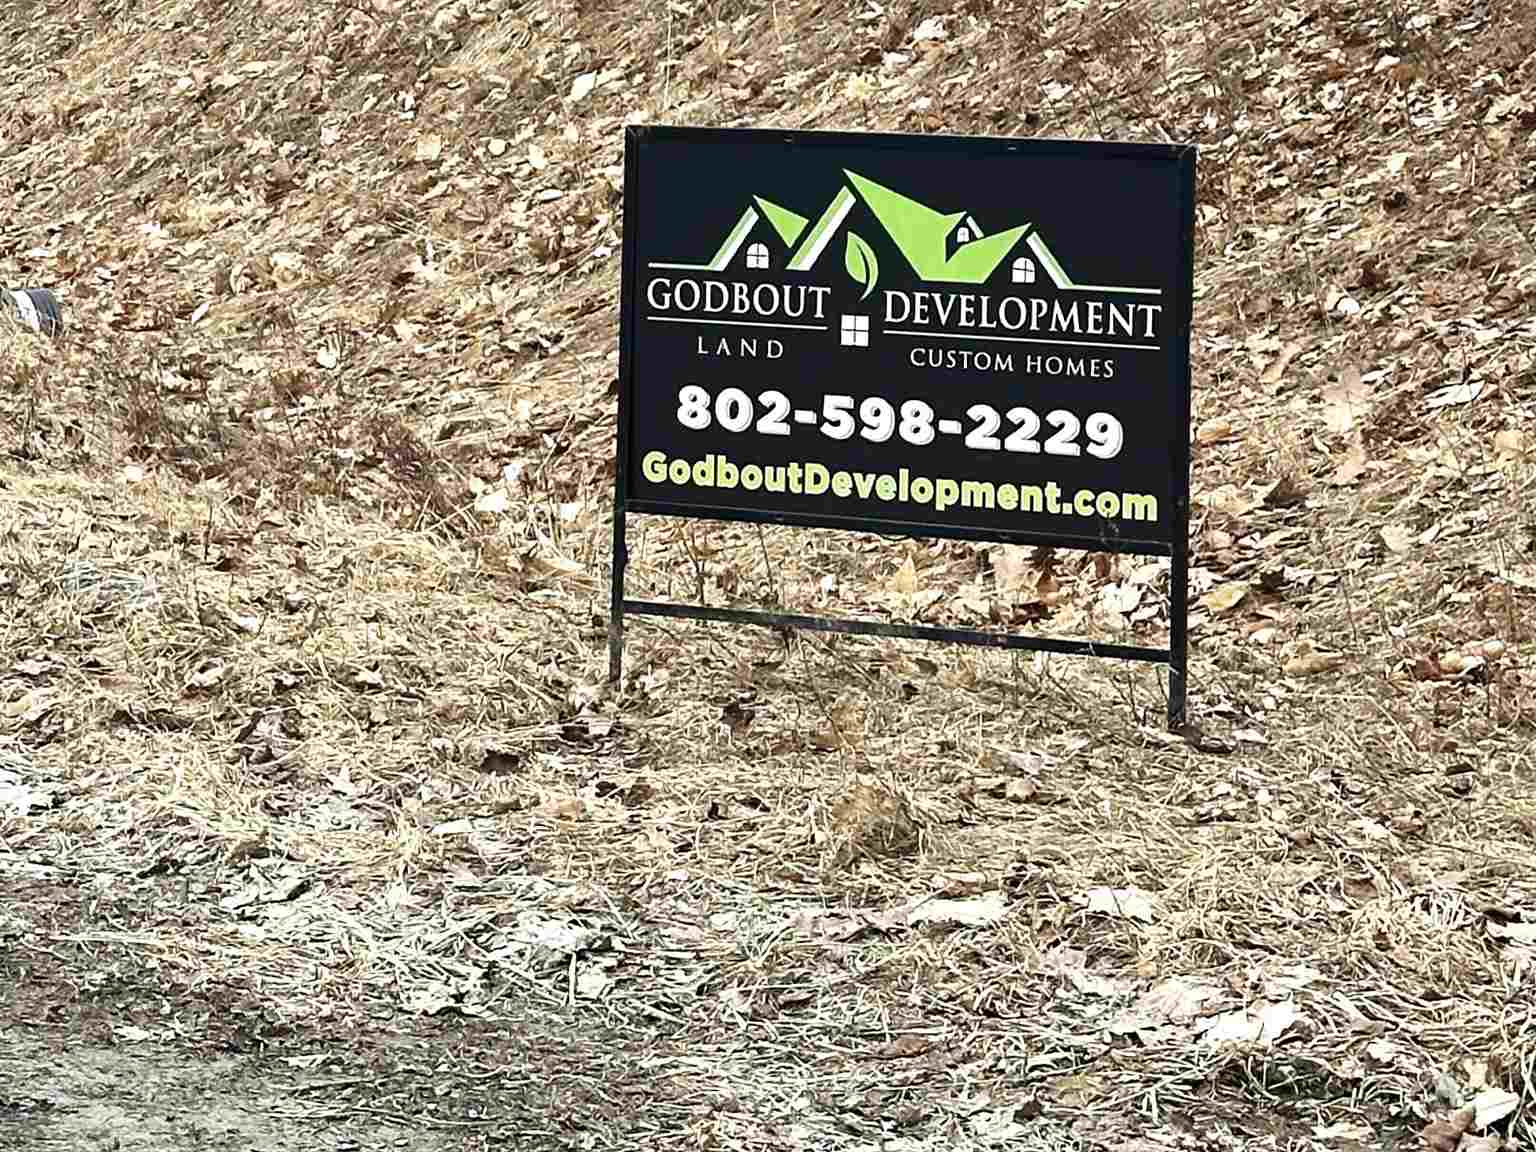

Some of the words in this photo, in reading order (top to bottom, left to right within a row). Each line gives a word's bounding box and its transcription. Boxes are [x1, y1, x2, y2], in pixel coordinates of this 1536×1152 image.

[646, 277, 831, 319] GODBOUT
[884, 289, 1163, 338] DEVELOPMENT
[697, 336, 785, 360] LAND
[910, 348, 1014, 373] CUSTOM
[1027, 355, 1115, 379] HOMES
[677, 384, 1125, 460] 802-598-2229
[642, 451, 1159, 522] GodboutDevelopment.com
